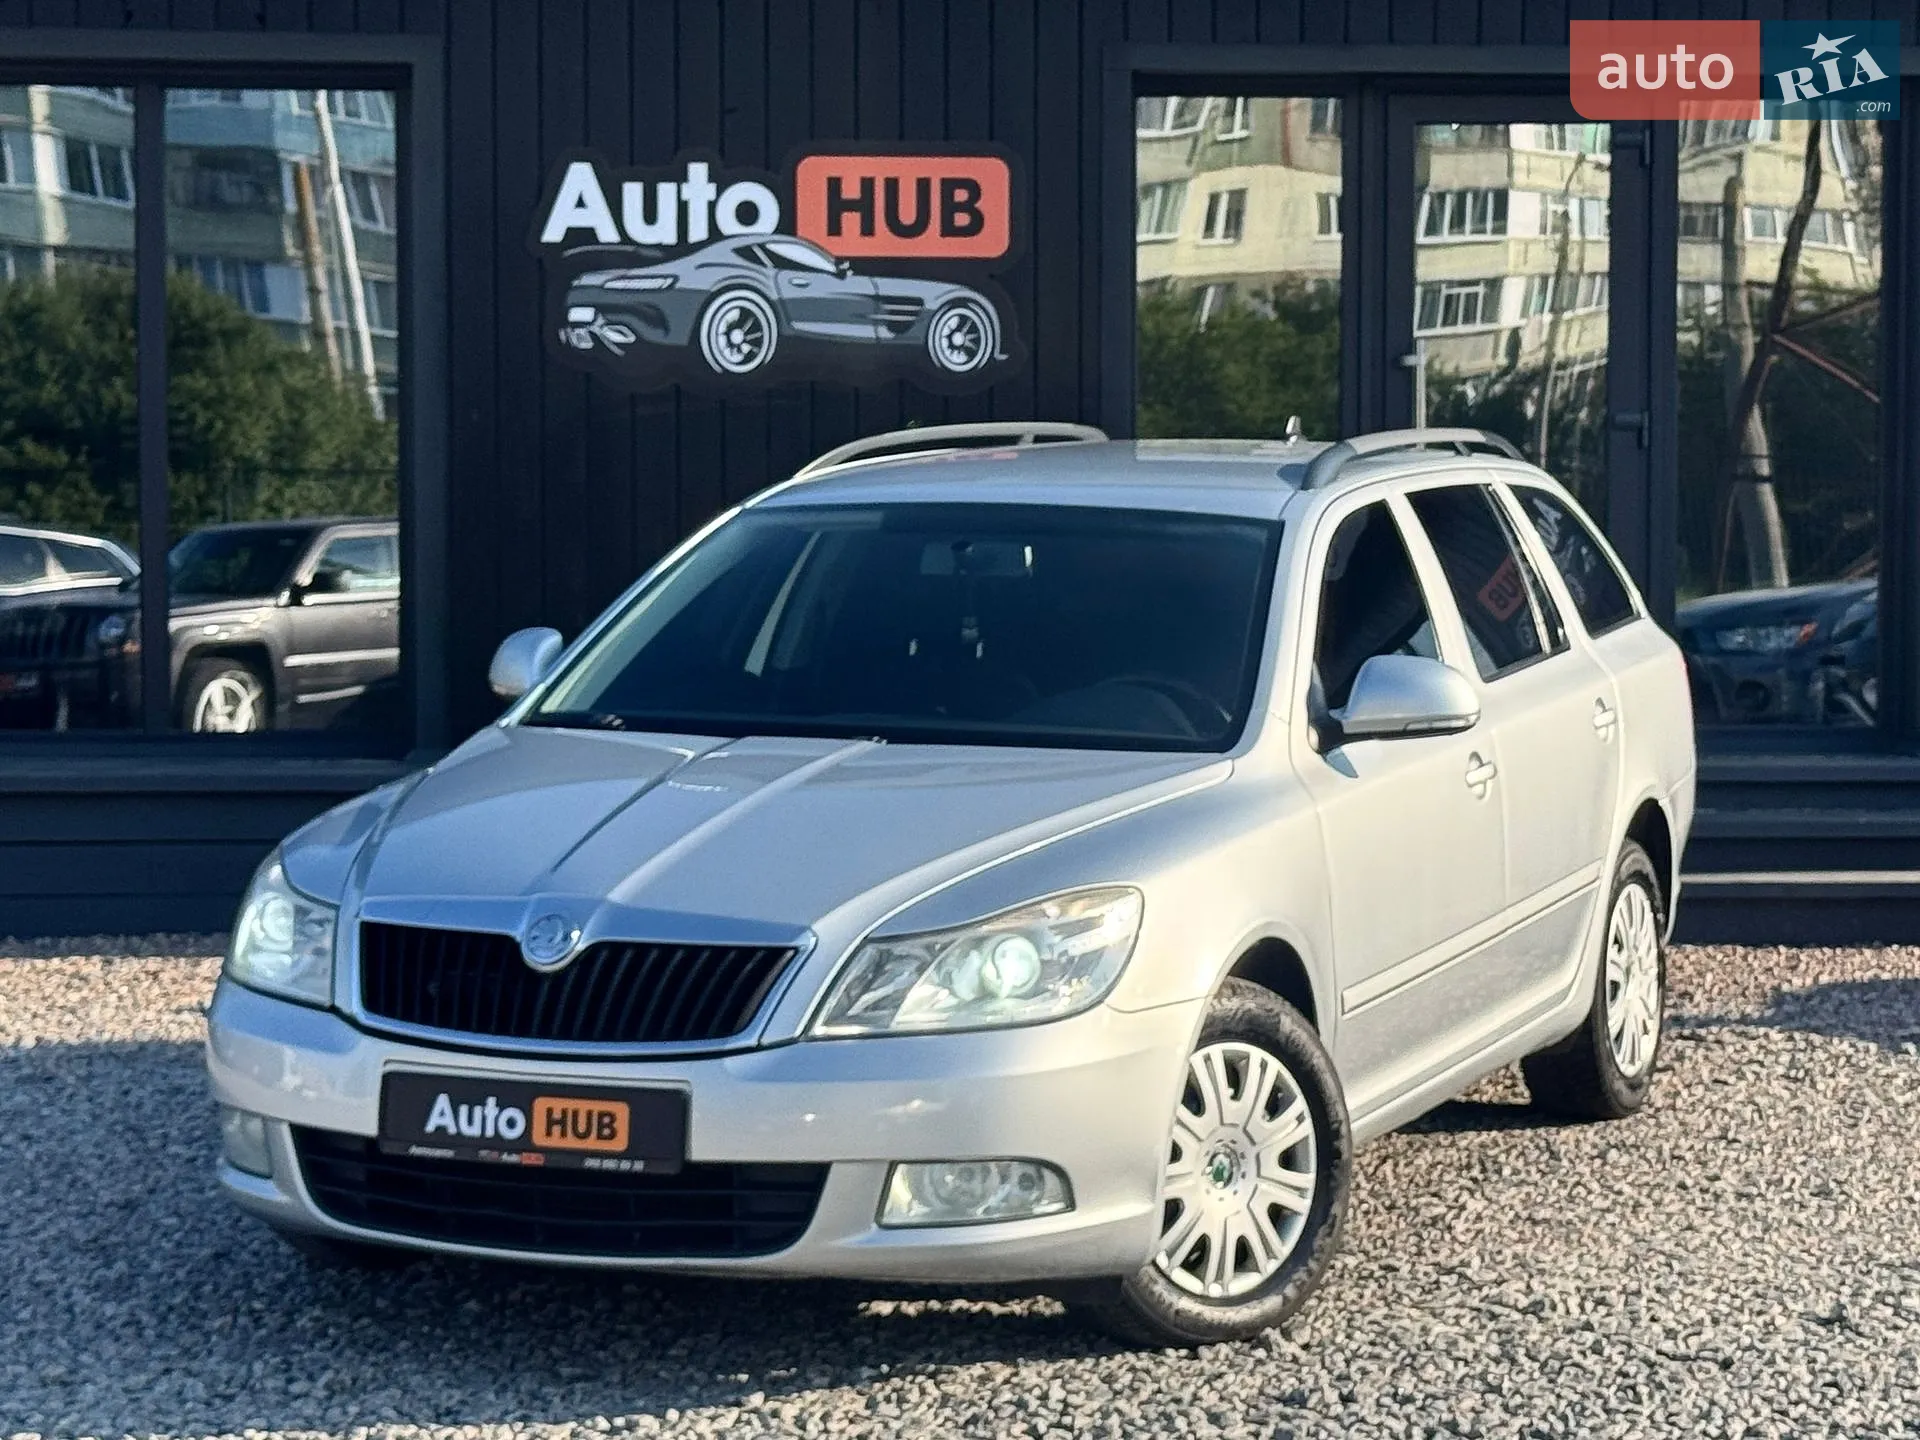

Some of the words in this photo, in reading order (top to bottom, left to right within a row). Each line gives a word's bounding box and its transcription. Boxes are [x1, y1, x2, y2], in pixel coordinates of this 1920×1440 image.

[540, 161, 780, 246] Auto
[826, 176, 985, 239] HUB
[423, 1092, 527, 1141] Auto
[543, 1106, 618, 1141] HUB
